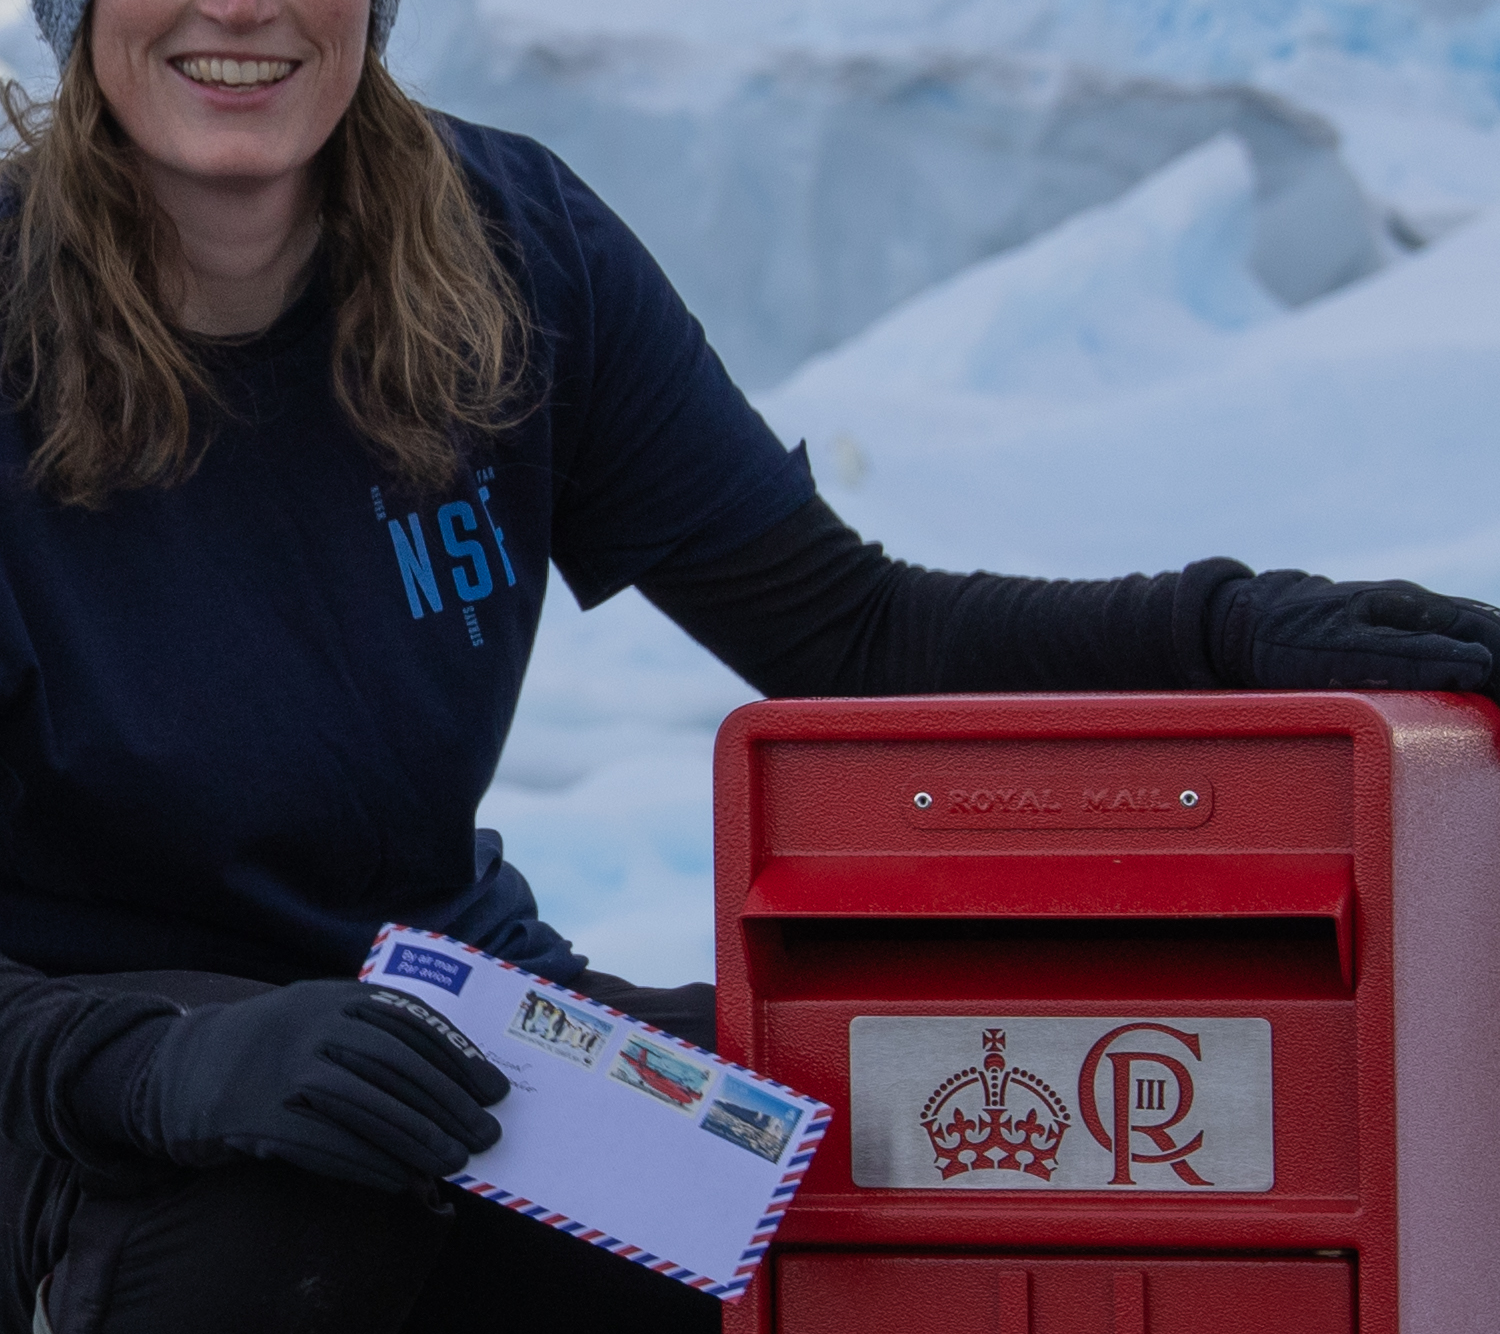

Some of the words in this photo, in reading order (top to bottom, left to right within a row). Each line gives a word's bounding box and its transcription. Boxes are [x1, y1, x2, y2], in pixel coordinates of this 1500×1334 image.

[476, 466, 495, 484] FAR
[462, 605, 484, 647] STRAYS
[949, 788, 1062, 814] ROYAL
[1082, 787, 1171, 813] MAIL
[397, 961, 419, 974] Par
[419, 968, 452, 986] avion
[401, 949, 417, 963] By
[418, 954, 434, 965] air
[434, 959, 459, 975] mail
[370, 991, 485, 1061] ziener
